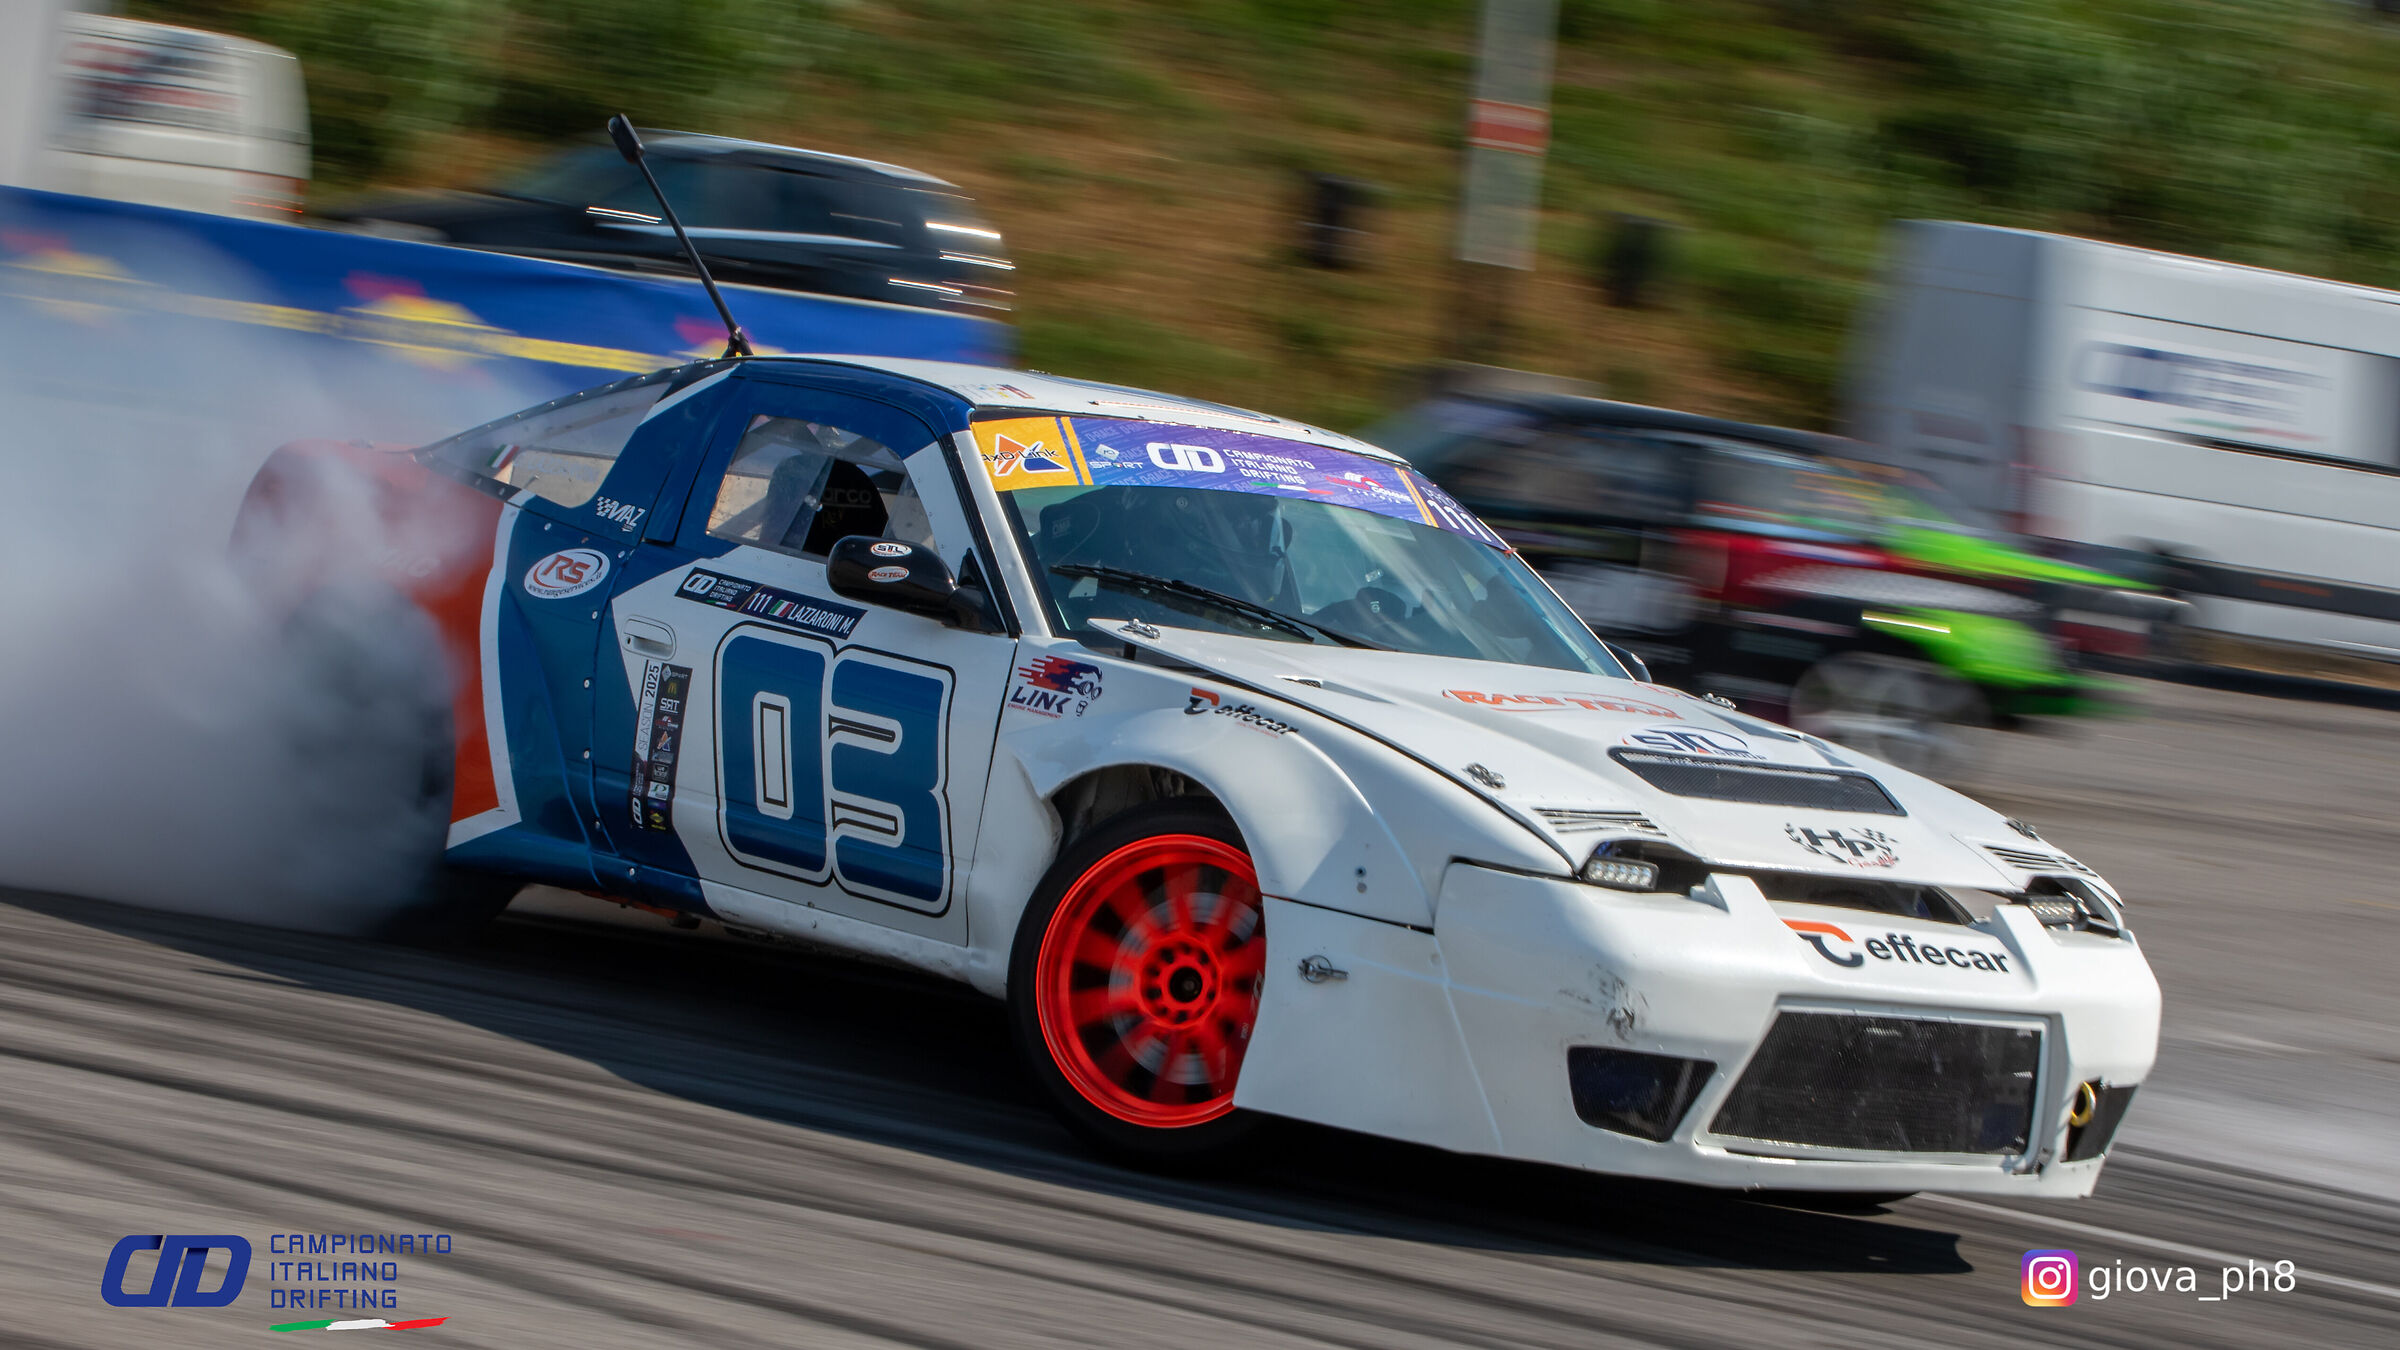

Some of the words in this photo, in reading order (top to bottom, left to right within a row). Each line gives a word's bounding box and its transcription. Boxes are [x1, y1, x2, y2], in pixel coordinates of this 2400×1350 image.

[1223, 449, 1316, 470] CAMPIONATO
[1231, 458, 1299, 475] ITALIANO
[1240, 468, 1307, 485] DRIFTING
[1427, 500, 1492, 542] 111
[541, 554, 591, 584] RS
[718, 579, 752, 592] CAMPIONATO
[747, 593, 773, 613] 111
[787, 604, 844, 632] LAZZARONI
[839, 618, 856, 635] M.
[645, 664, 660, 698] 2025
[1007, 702, 1026, 711] ENGINE
[1027, 707, 1062, 719] MANAGEMENT
[1011, 686, 1072, 714] LINK
[1448, 688, 1566, 707] RACE
[638, 702, 653, 750] SEASON
[714, 622, 954, 916] 03
[1800, 827, 1876, 857] HP
[1865, 932, 2010, 973] effecar
